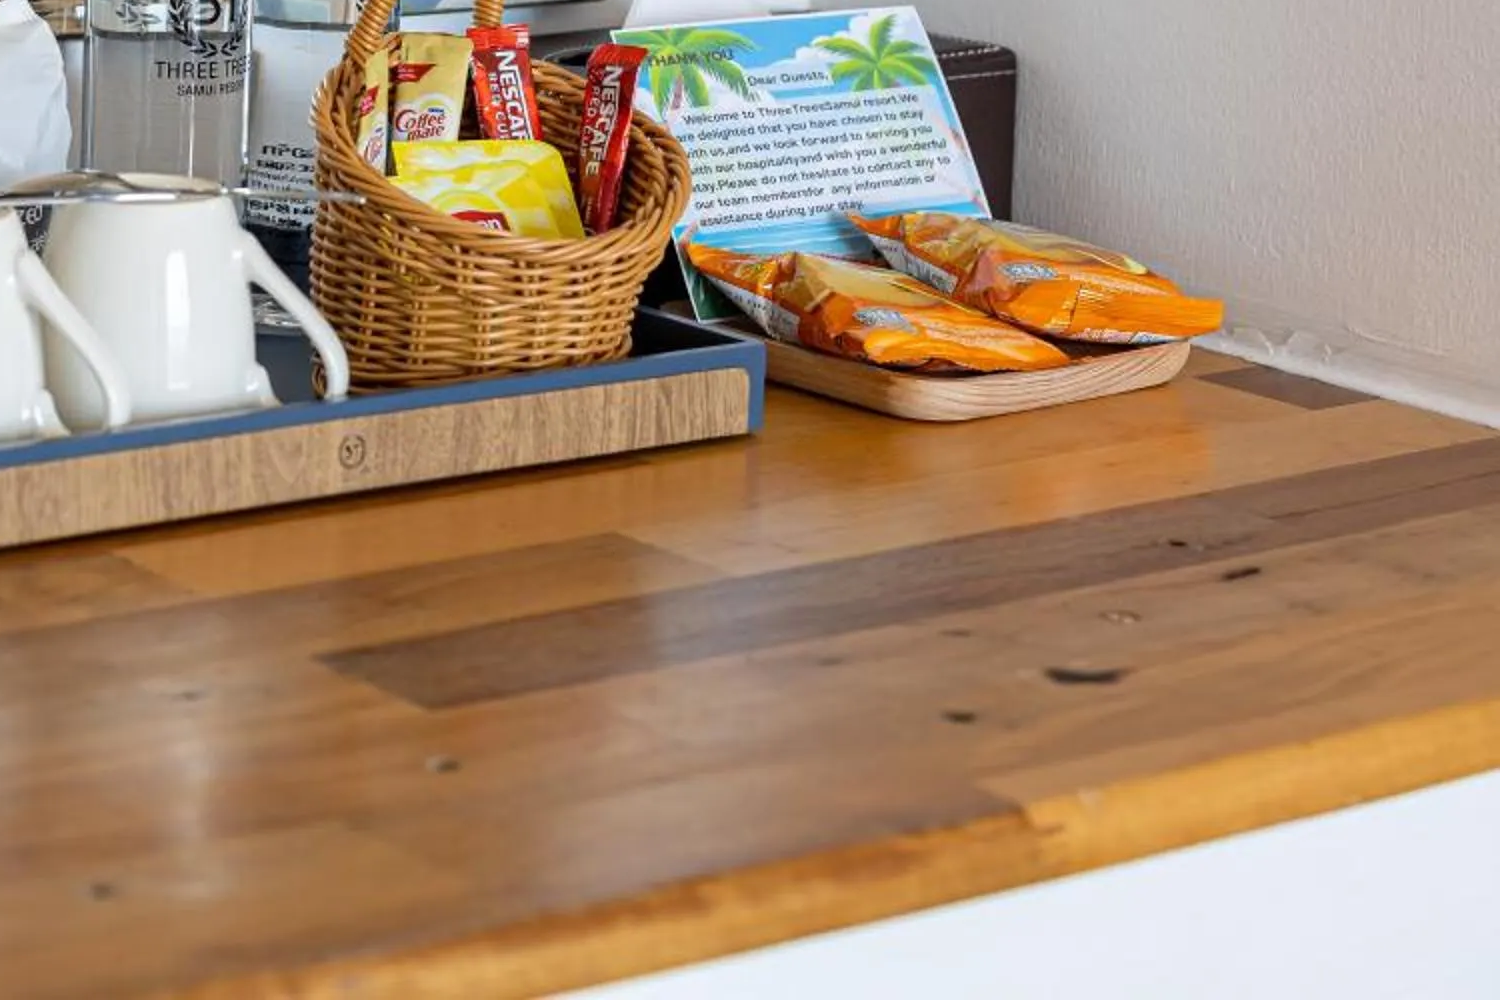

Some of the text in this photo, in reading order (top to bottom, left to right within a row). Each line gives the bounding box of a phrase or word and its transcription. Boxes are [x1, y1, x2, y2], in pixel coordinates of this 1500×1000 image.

[154, 60, 219, 79] THREE
[648, 48, 734, 67] THANK YOU
[177, 83, 217, 97] SAMUI
[748, 74, 777, 87] Dear
[494, 50, 533, 139] NESCAF
[395, 109, 446, 133] Coffee
[683, 110, 739, 125] Welcome
[742, 110, 755, 120] to
[698, 124, 755, 141] delighted
[757, 123, 781, 134] that
[784, 121, 807, 133] you
[809, 118, 838, 129] have
[841, 112, 883, 126] chosen
[884, 111, 897, 121] to
[900, 109, 924, 121] stay
[407, 126, 445, 141] mate
[753, 141, 771, 151] we
[773, 137, 798, 149] look
[801, 131, 849, 147] forward
[850, 131, 863, 141] to
[866, 127, 909, 140] serving
[911, 125, 933, 137] you
[715, 163, 735, 173] our
[825, 149, 853, 161] wish
[855, 149, 877, 161] you
[879, 147, 887, 155] a
[890, 138, 947, 153] wonderful
[761, 174, 777, 185] do
[779, 173, 798, 183] not
[801, 167, 849, 181] hesitate
[851, 165, 865, 175] to
[867, 160, 912, 173] contact
[914, 158, 935, 169] any
[937, 155, 951, 165] to
[695, 199, 715, 210] our
[717, 195, 750, 207] team
[831, 185, 853, 196] any
[855, 175, 922, 191] information
[924, 174, 935, 184] or
[700, 211, 763, 226] assistance
[765, 205, 806, 219] during
[808, 202, 835, 217] your
